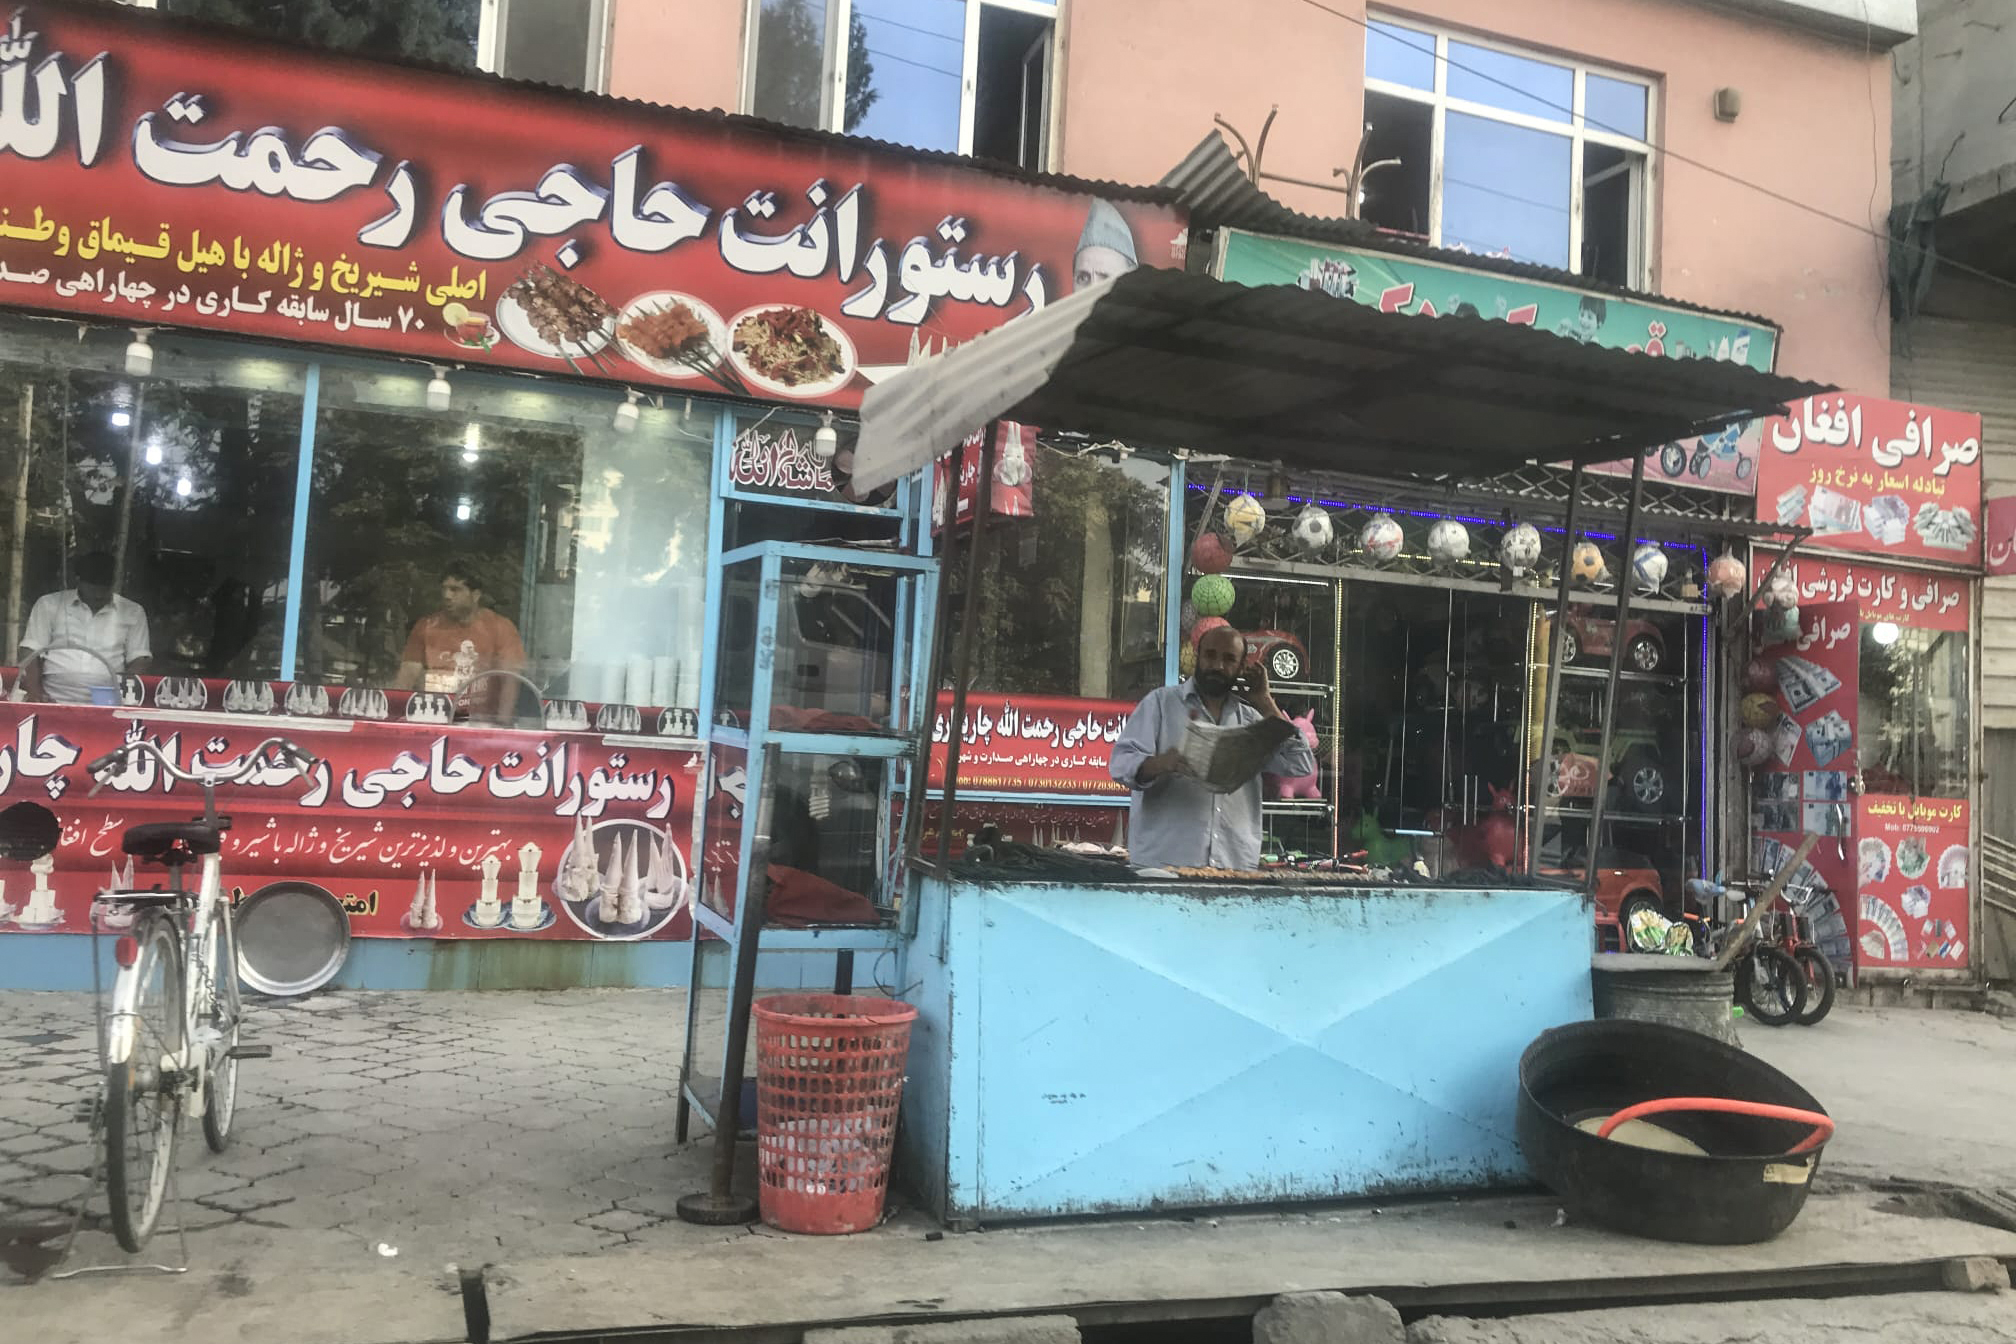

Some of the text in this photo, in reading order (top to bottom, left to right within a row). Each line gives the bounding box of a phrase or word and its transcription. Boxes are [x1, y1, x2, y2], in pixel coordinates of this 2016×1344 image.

[0, 5, 1048, 324] رستورانت حاجی رحمت الل
[76, 215, 171, 264] قیماق
[176, 229, 227, 274] هیل
[232, 235, 251, 280] با
[256, 239, 304, 289] ژاله
[308, 260, 325, 292] و
[329, 251, 421, 299] شیریخ
[55, 267, 157, 309] چهاراهی
[161, 283, 191, 312] در
[195, 285, 273, 318] کاری
[424, 265, 488, 307] اصلی
[276, 294, 330, 327] سابقه
[333, 300, 393, 332] سال
[1771, 396, 1980, 476] صرافی افغان
[1809, 463, 1832, 485] روز
[1877, 471, 1910, 494] اسعار
[1801, 566, 1855, 602] فروشی
[1857, 573, 1896, 607] کارت
[1899, 587, 1908, 610] و
[1911, 577, 1960, 614] صرافی
[1796, 614, 1851, 652] صرافی
[996, 699, 1020, 739] الله
[1021, 711, 1061, 749] رحمت
[1062, 711, 1103, 749] حاجی
[341, 735, 486, 809] حاجی
[487, 740, 676, 819] رستورانت
[1898, 798, 1906, 820] با
[1906, 801, 1937, 824] موبایل
[1938, 803, 1963, 824] کارت
[89, 812, 124, 857] سطح
[237, 816, 278, 857] شیر
[273, 832, 282, 864] با
[283, 826, 320, 855] ژاله
[320, 841, 328, 855] و
[329, 820, 384, 864] شیریخ
[447, 842, 458, 857] و
[458, 829, 513, 870] بهترین
